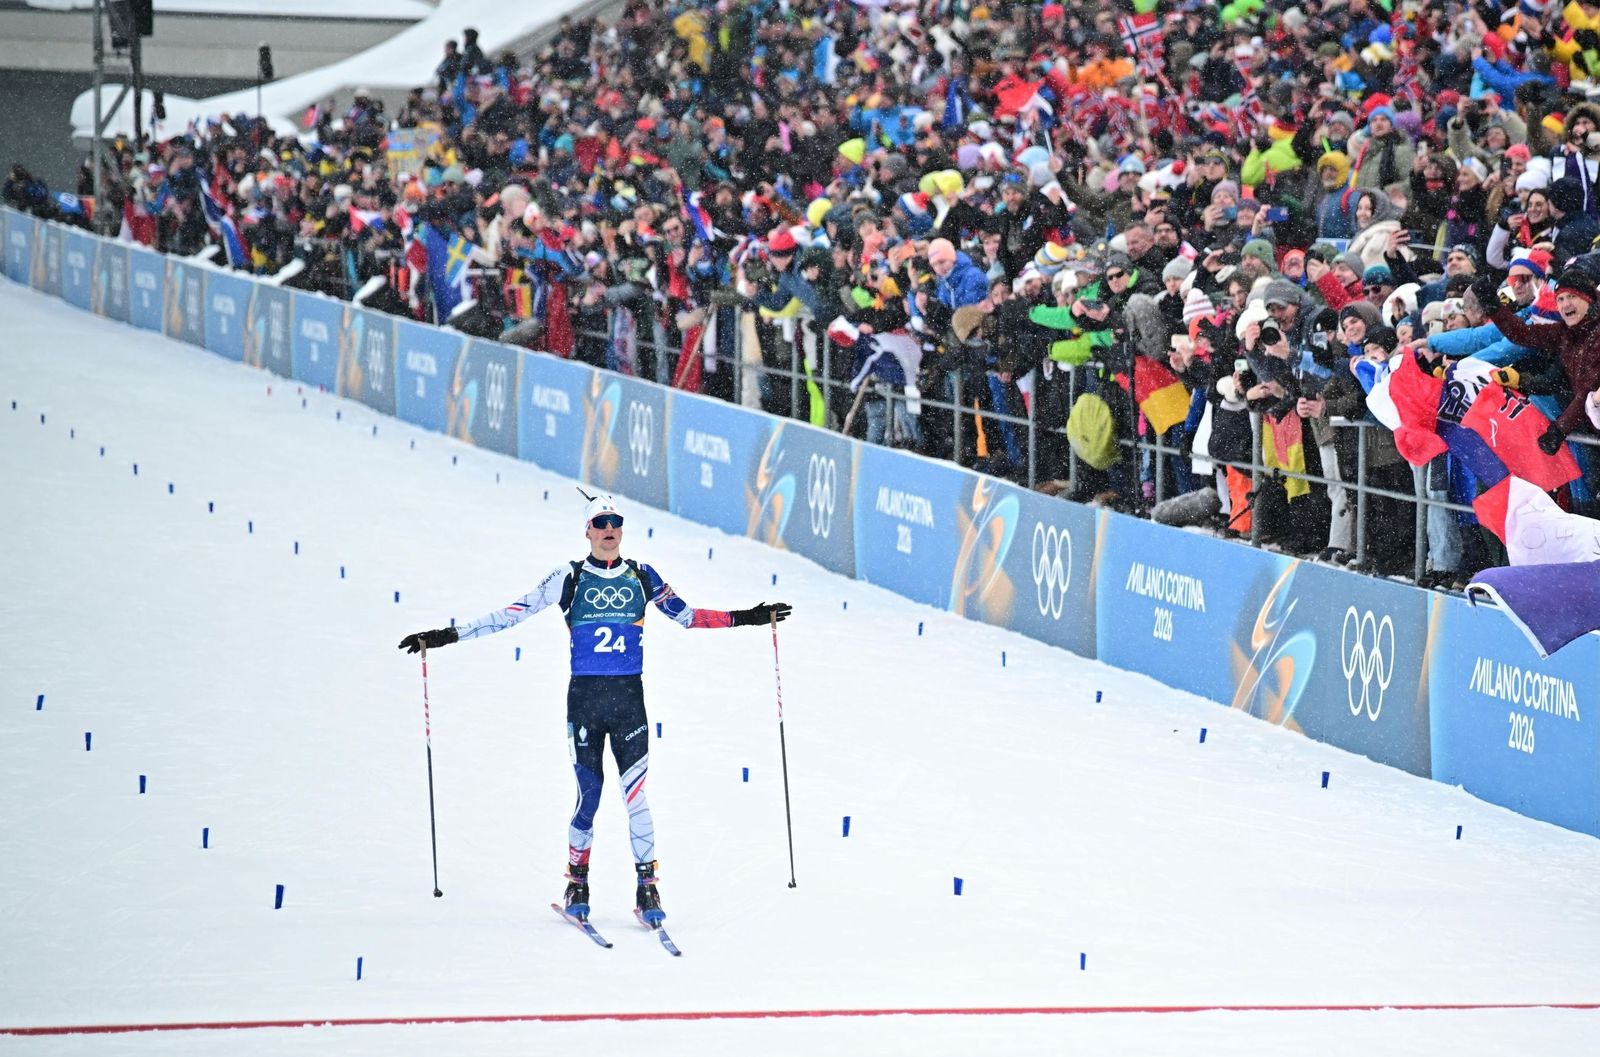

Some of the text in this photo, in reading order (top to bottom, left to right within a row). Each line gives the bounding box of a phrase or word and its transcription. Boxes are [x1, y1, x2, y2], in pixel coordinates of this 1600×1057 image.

[1125, 561, 1206, 613] MILANO CORTINA
[1153, 606, 1173, 642] 2026
[1469, 655, 1580, 722] MILANO CORTINA
[625, 725, 646, 741] CRAFT
[1508, 711, 1535, 755] 2026
